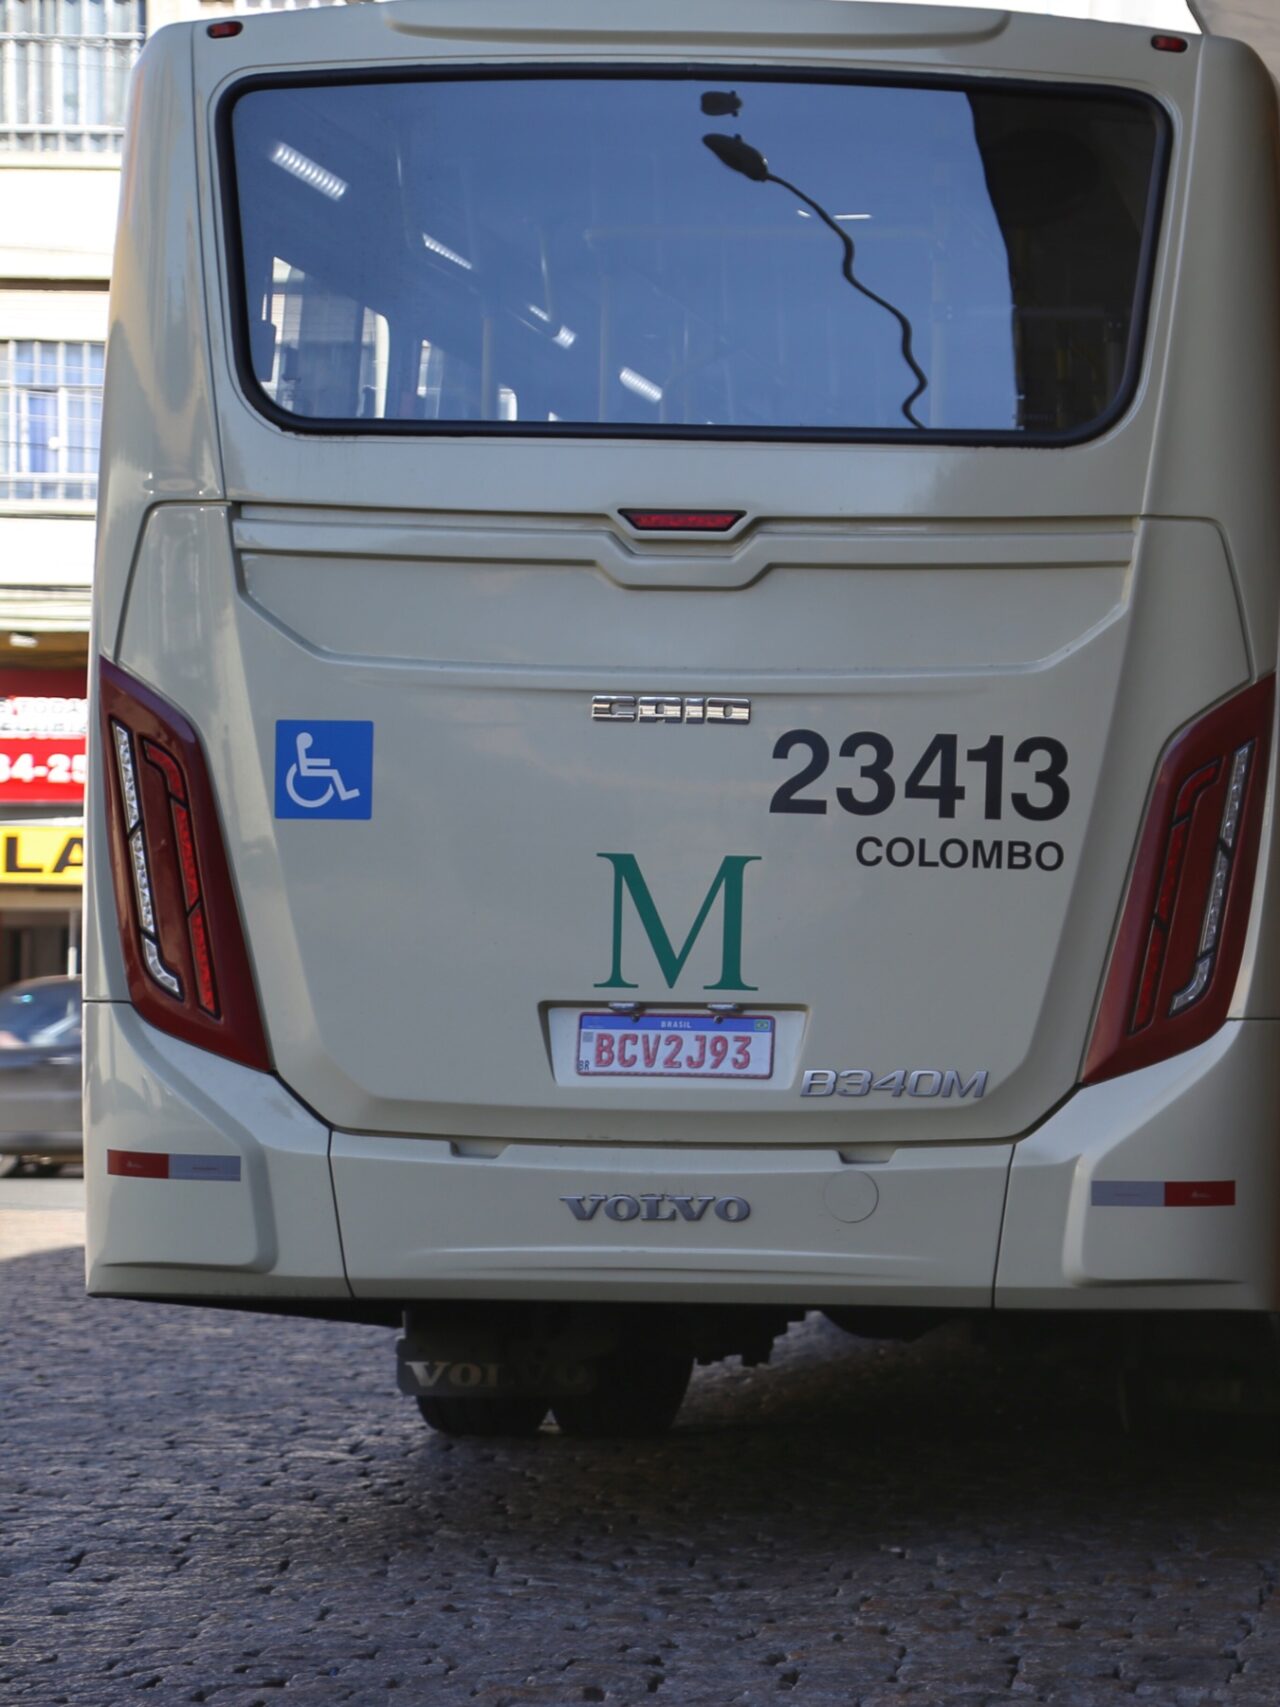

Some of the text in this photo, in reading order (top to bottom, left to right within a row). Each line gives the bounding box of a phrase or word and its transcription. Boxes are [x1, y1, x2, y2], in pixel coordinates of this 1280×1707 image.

[591, 695, 752, 725] CAIO
[769, 728, 1071, 822] 23413
[855, 835, 1065, 872] COLOMBO
[593, 852, 763, 992] M
[660, 1020, 692, 1030] BRASIL
[594, 1032, 753, 1071] BCV2J93
[800, 1069, 990, 1099] B340M
[559, 1194, 753, 1223] VOLVO
